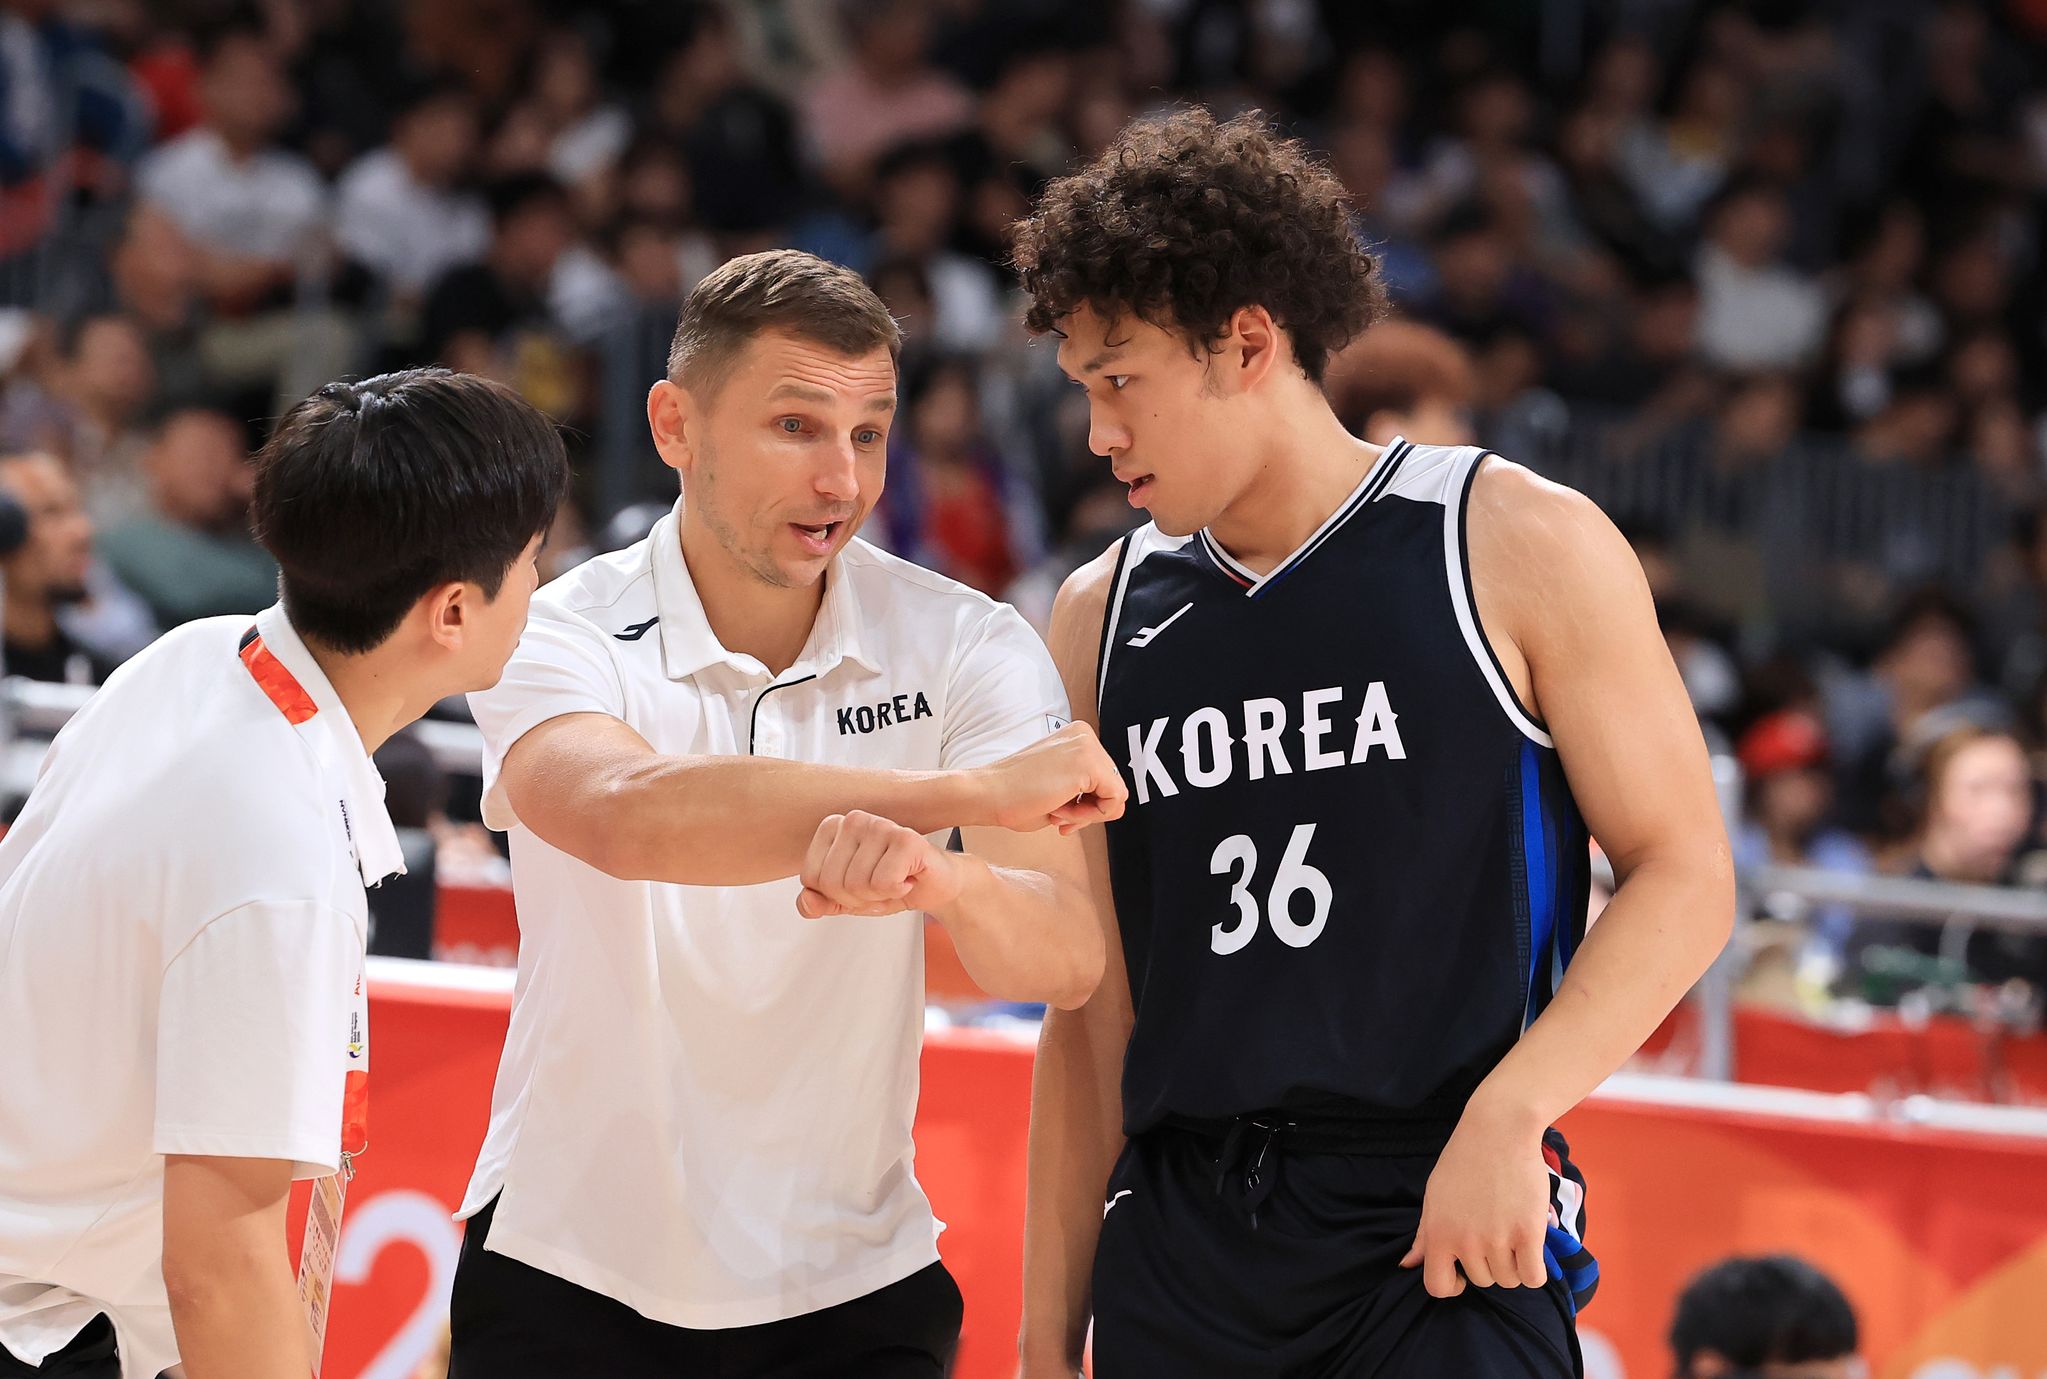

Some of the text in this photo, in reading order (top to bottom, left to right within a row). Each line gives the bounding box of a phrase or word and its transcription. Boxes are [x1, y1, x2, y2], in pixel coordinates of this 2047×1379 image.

[836, 691, 933, 736] KOREA
[1127, 681, 1407, 805] KOREA
[1210, 822, 1333, 956] 36
